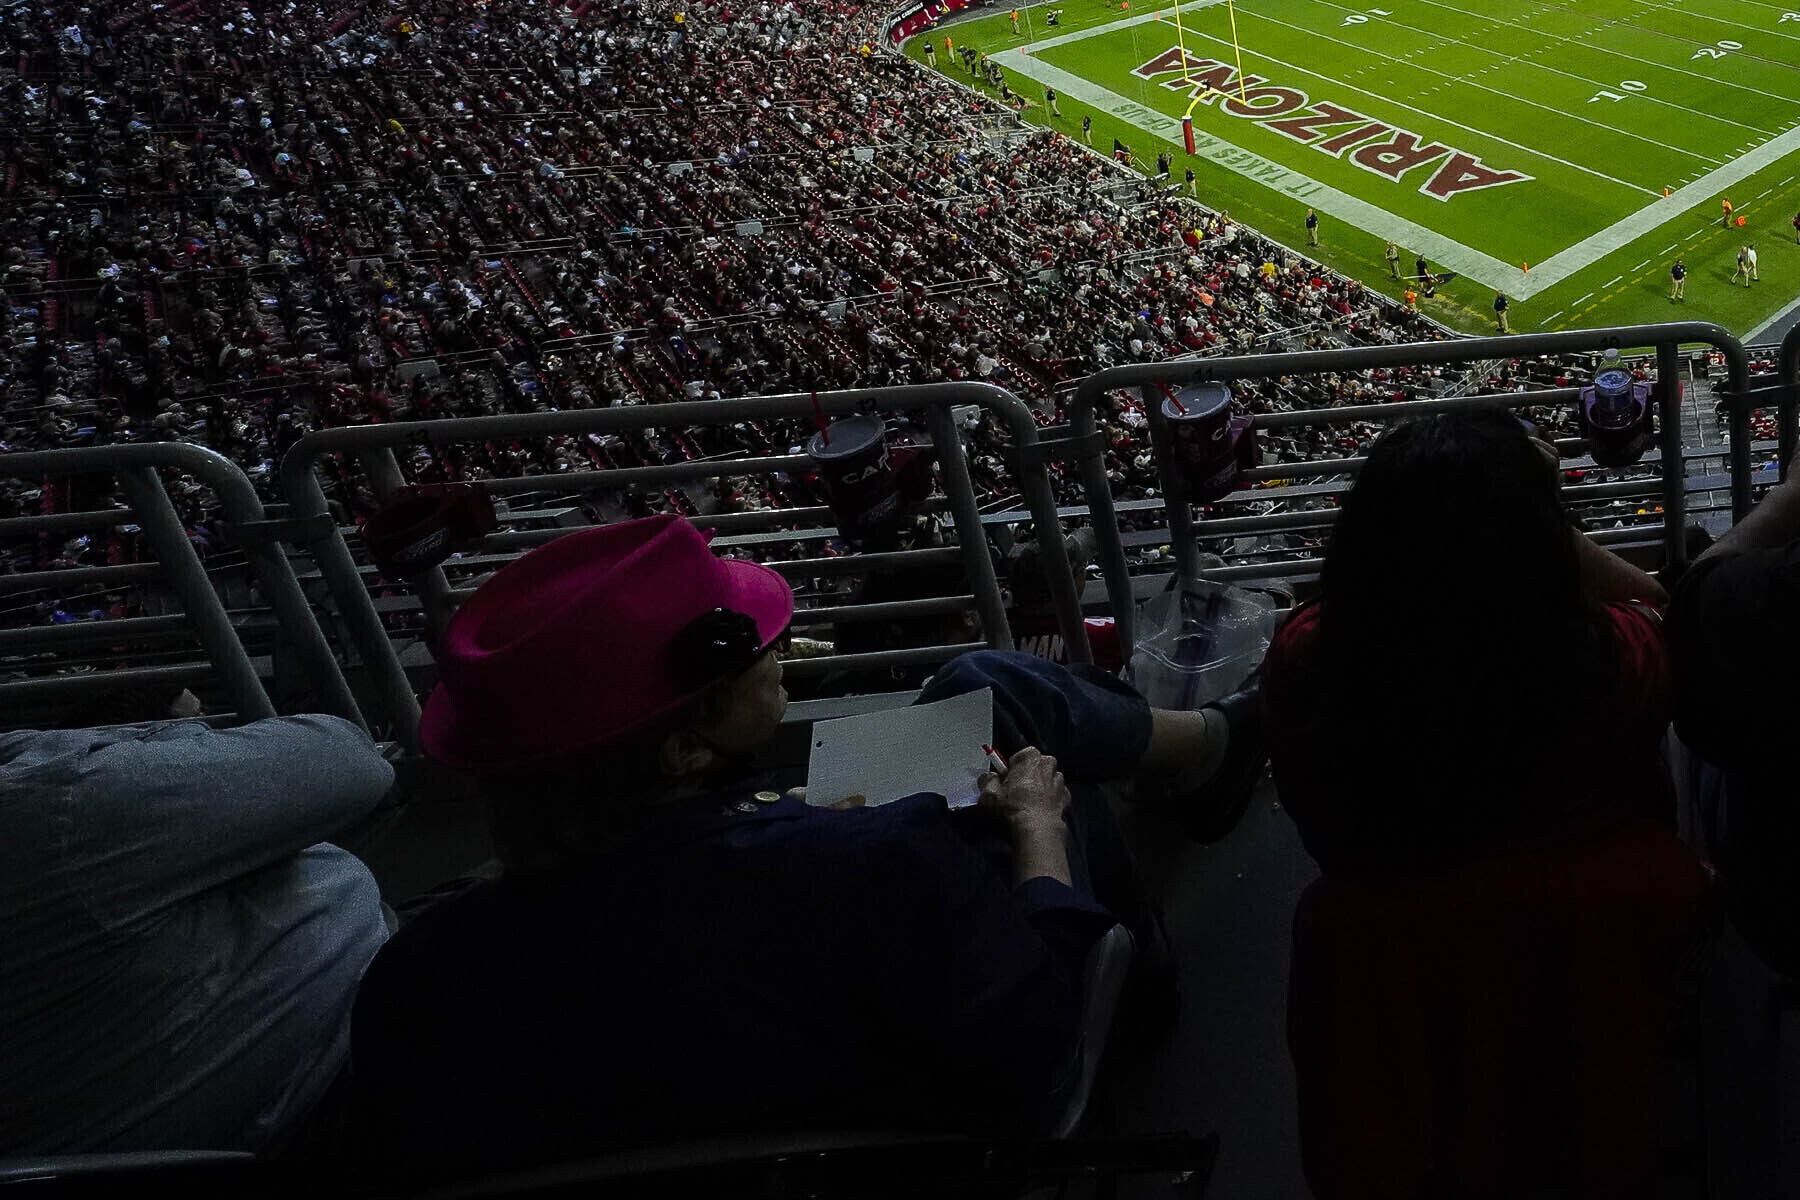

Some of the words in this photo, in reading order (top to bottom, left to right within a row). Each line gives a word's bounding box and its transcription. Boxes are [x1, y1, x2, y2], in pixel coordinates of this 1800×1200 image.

[1346, 7, 1394, 27] 10
[1696, 40, 1743, 60] 20
[1588, 80, 1648, 104] 10
[1112, 103, 1149, 119] US
[1129, 45, 1537, 202] ARIZONA
[1140, 117, 1176, 131] OF
[1211, 148, 1291, 184] TAKES
